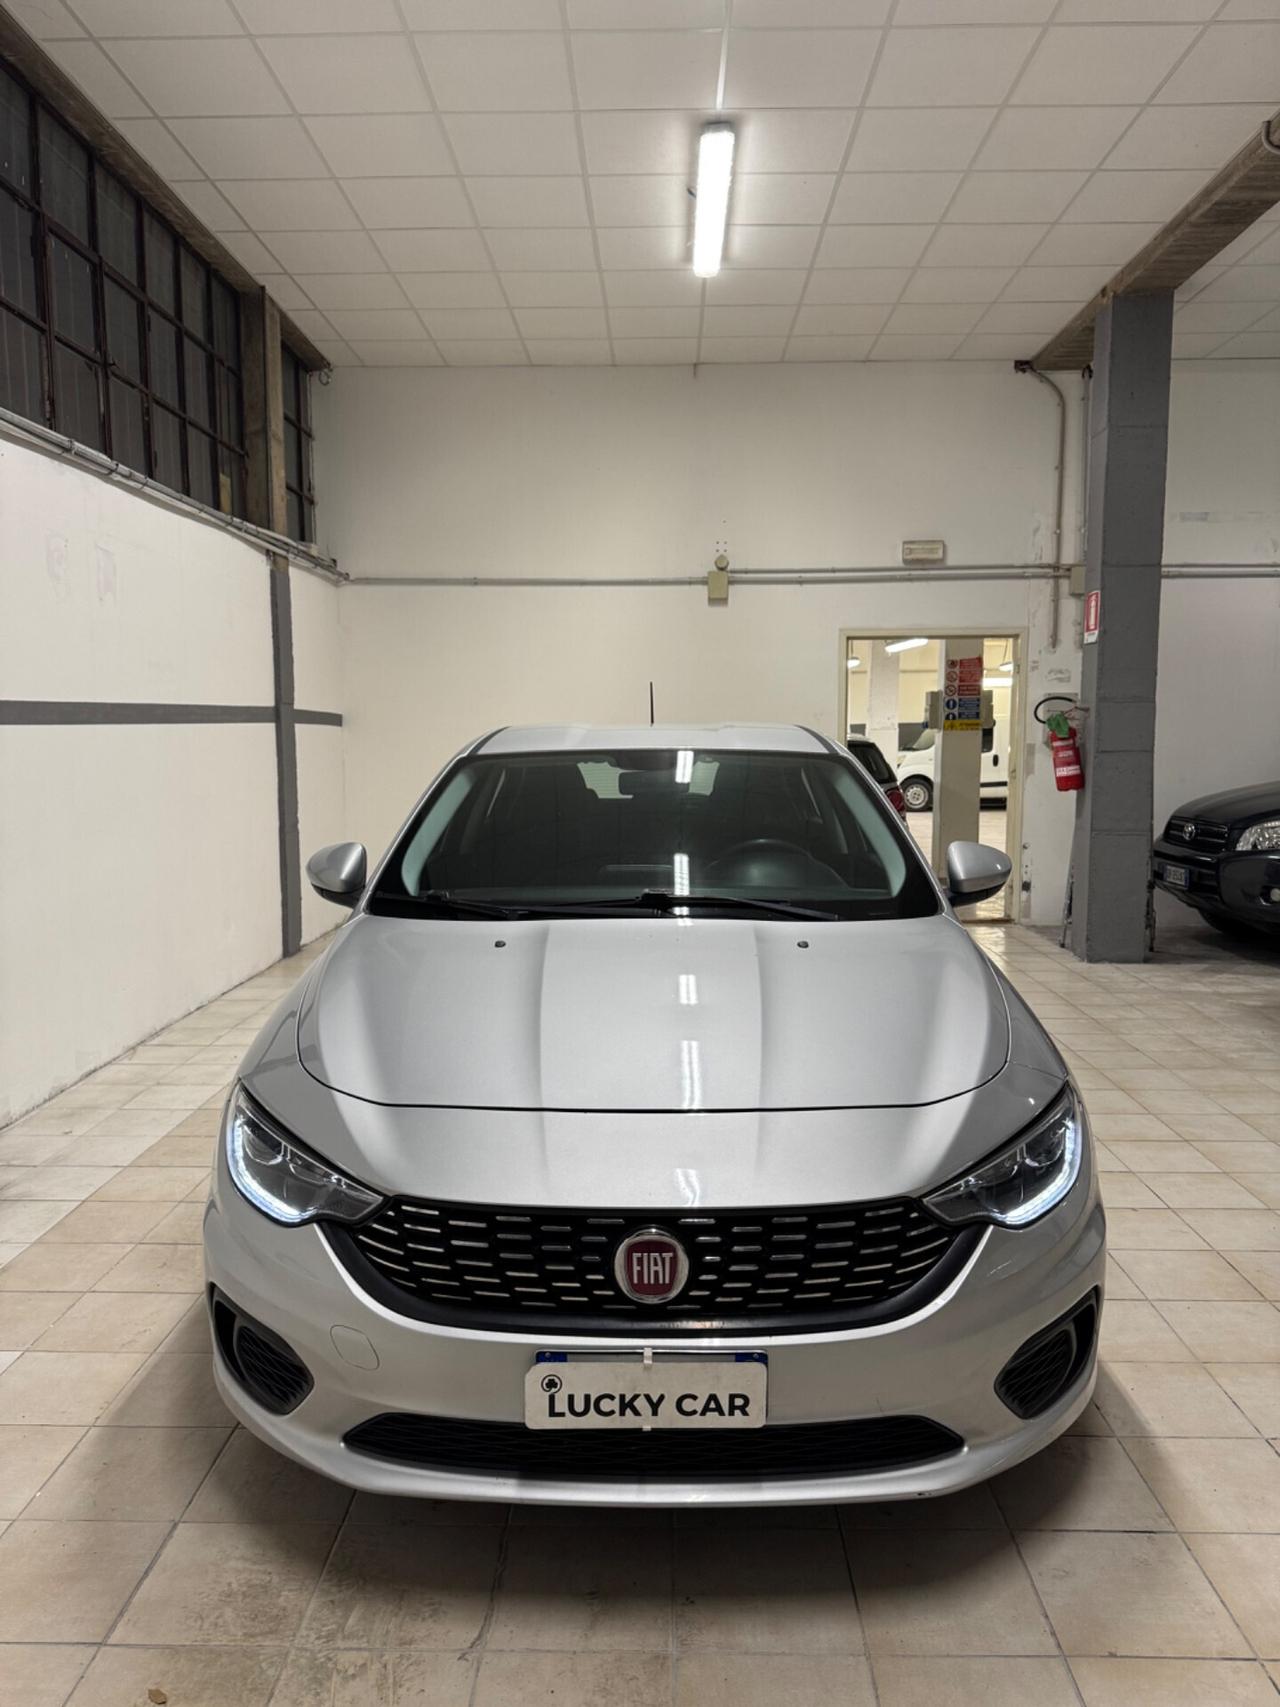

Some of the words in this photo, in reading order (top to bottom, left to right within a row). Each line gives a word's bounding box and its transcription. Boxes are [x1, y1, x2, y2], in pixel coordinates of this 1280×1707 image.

[632, 1252, 674, 1285] FIAT
[547, 1391, 666, 1418] LUCKY
[675, 1392, 751, 1417] CAR
